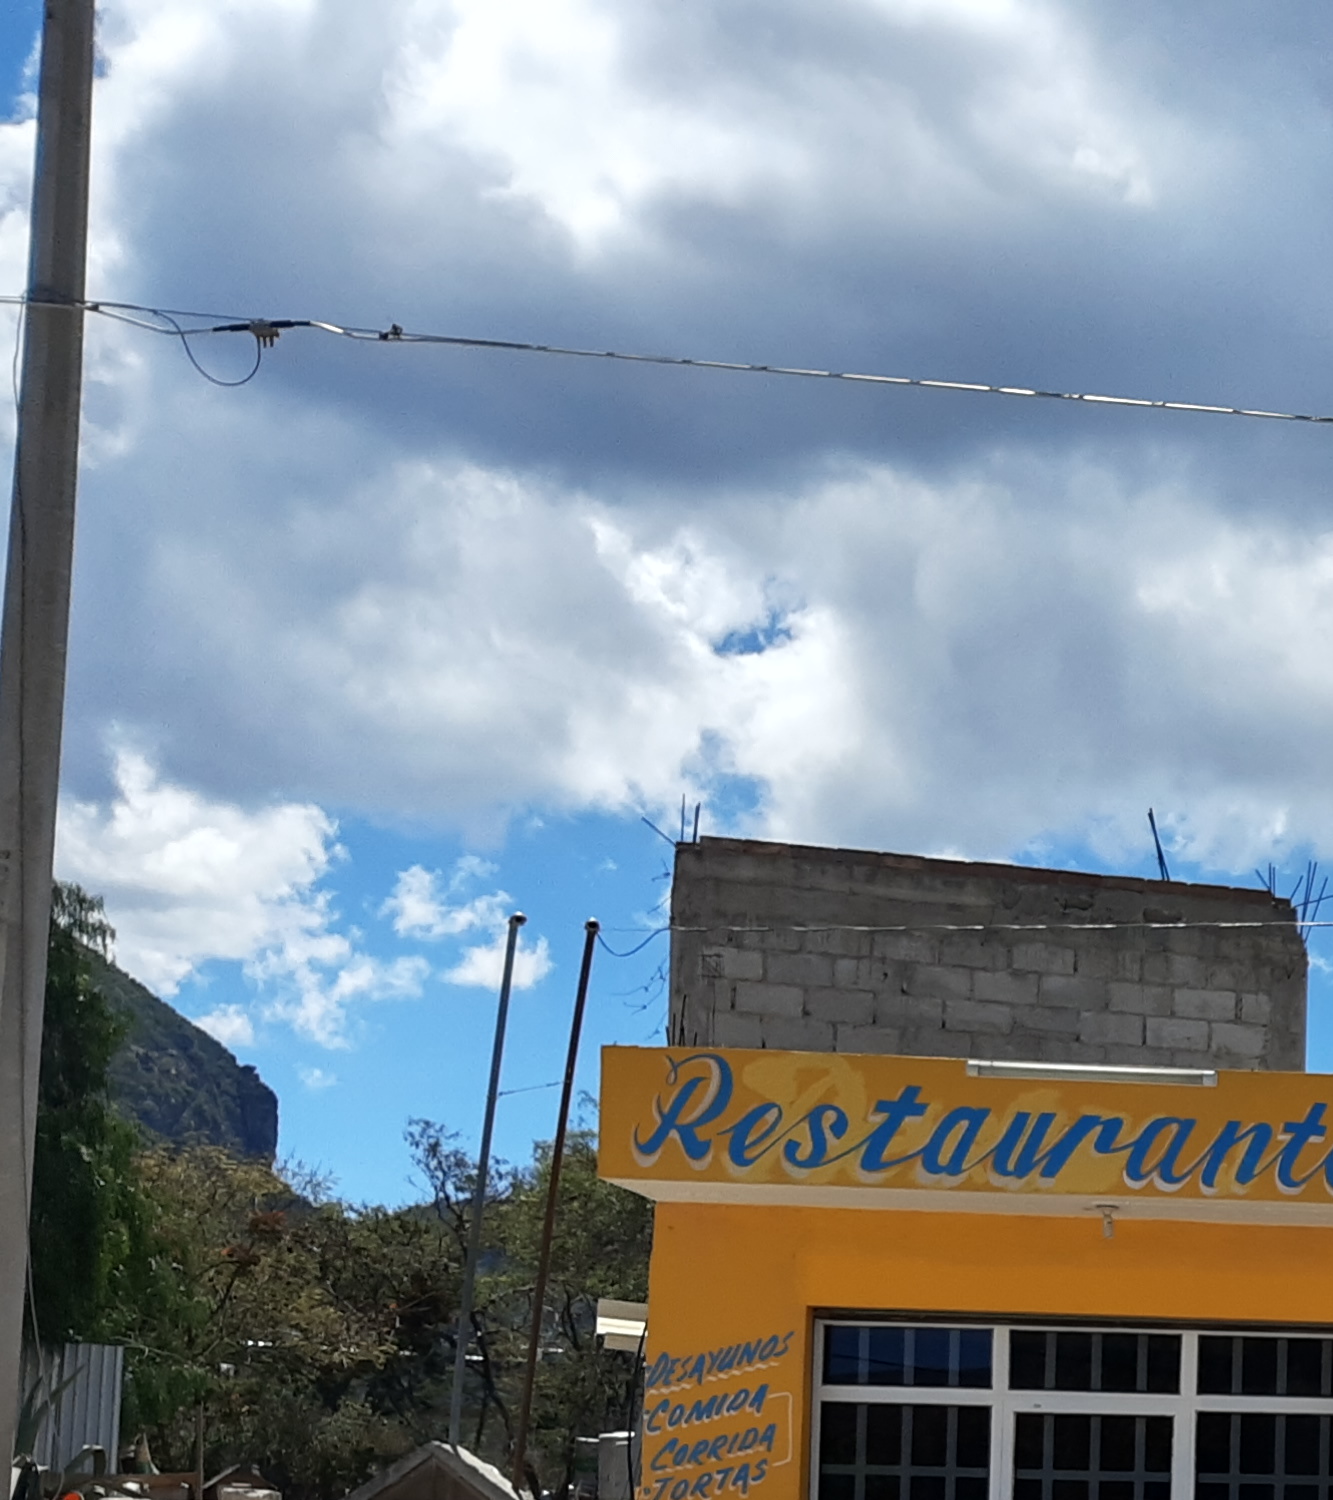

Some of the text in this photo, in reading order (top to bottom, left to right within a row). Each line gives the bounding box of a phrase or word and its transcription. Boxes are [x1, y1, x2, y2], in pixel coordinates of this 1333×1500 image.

[646, 1330, 795, 1388] DESAYUNOS
[647, 1384, 769, 1434] COMIDA
[650, 1423, 777, 1472] CORRIDA
